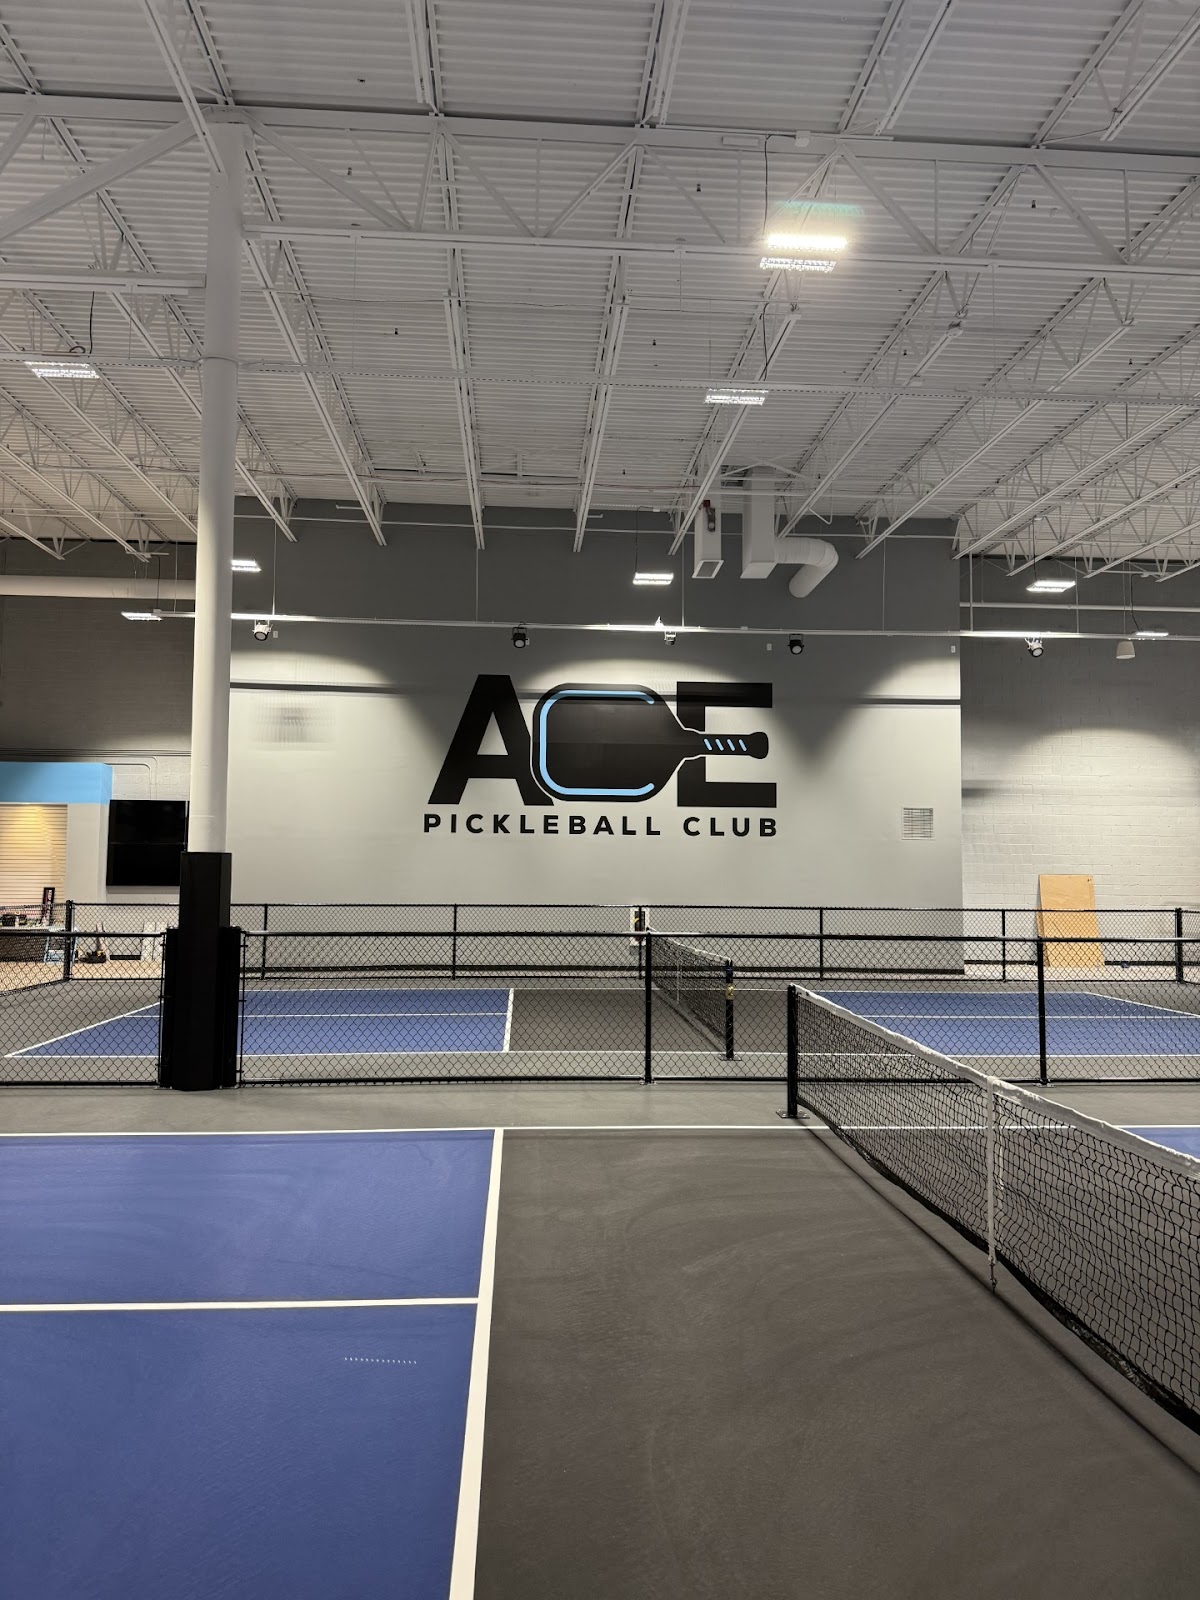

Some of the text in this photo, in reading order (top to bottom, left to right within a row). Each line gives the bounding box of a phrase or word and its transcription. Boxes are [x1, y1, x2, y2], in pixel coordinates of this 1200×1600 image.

[427, 674, 777, 808] ACE
[424, 813, 778, 838] PICKLEBALL CLUB
